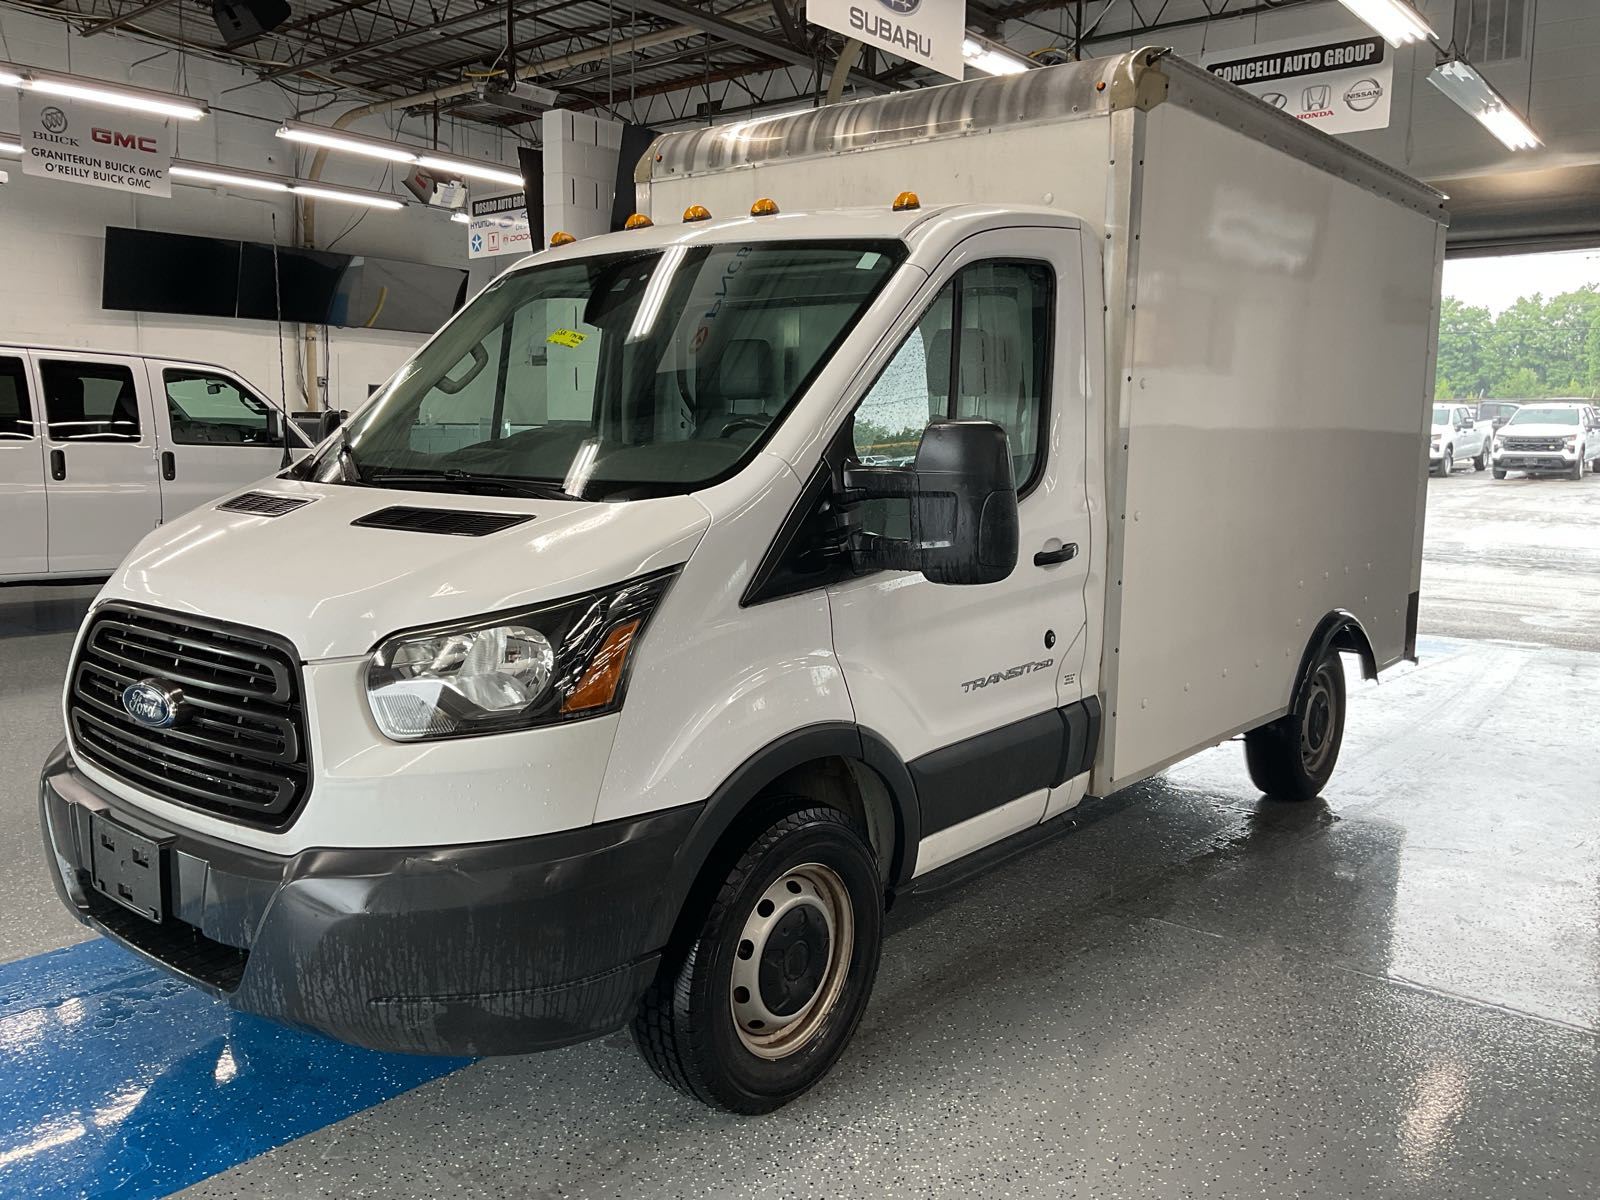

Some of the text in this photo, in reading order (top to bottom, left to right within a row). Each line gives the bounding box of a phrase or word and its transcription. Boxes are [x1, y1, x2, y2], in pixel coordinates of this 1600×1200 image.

[850, 6, 931, 58] SUBARU
[1214, 43, 1375, 82] CONICELLI AUTO GROUP
[1346, 90, 1380, 99] NISSAN
[1296, 110, 1334, 119] HONDA
[32, 130, 80, 147] BUICK
[91, 127, 157, 153] GMC
[31, 147, 162, 179] GRANITERUN BUICK GMC
[45, 162, 151, 189] O'REILLY BUICK GMC
[498, 198, 512, 210] AUTO
[128, 689, 158, 719] Ford
